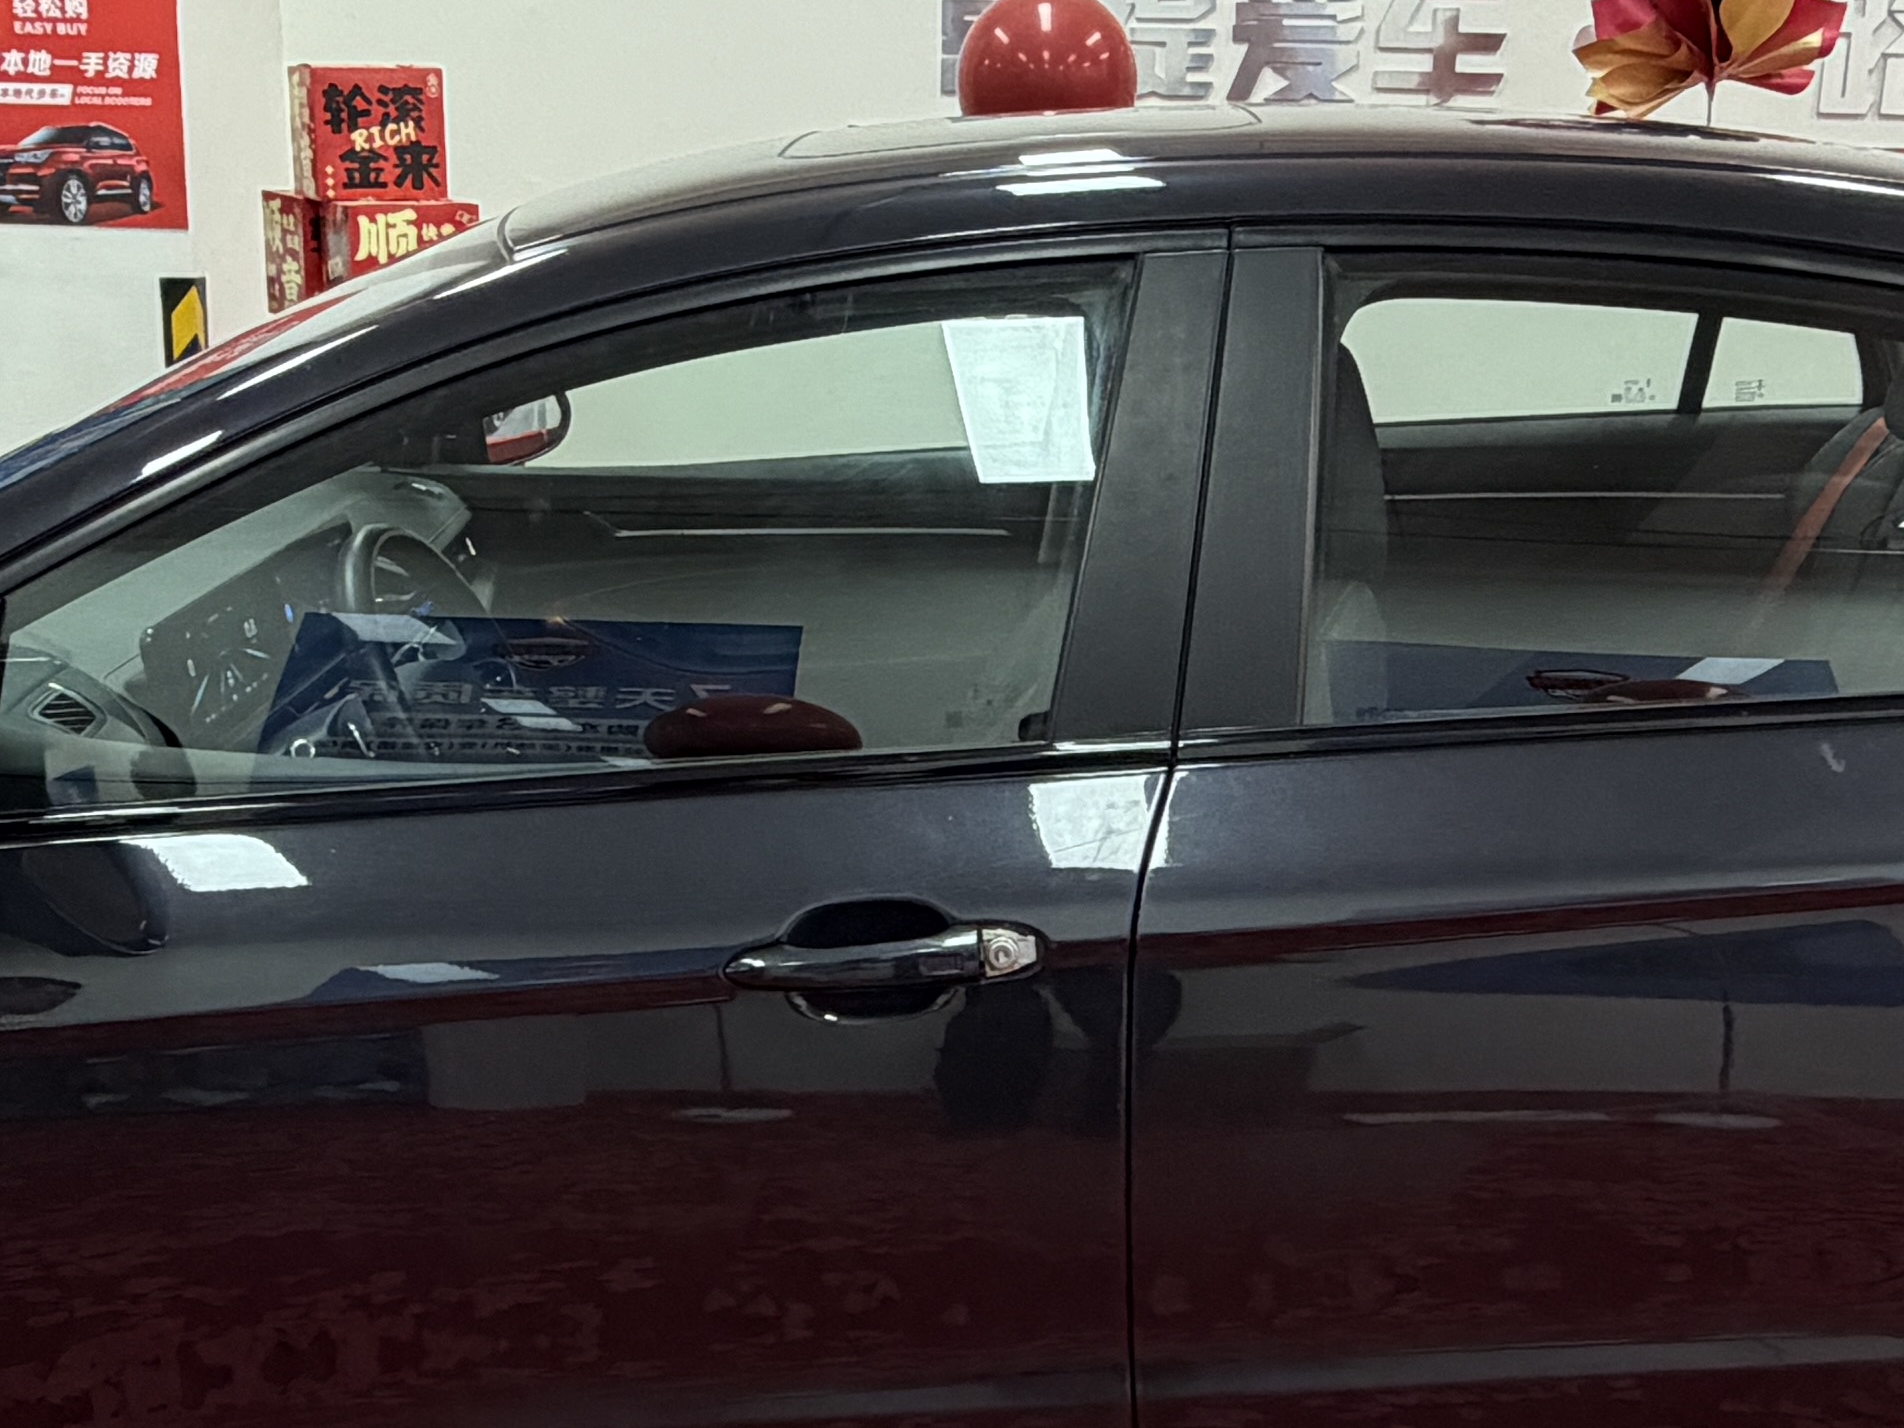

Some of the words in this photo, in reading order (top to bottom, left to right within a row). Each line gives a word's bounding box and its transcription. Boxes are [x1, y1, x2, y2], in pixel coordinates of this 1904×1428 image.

[13, 21, 53, 35] EASY
[56, 22, 88, 36] BUY
[350, 119, 417, 152] RICH
[353, 207, 418, 265] 顺
